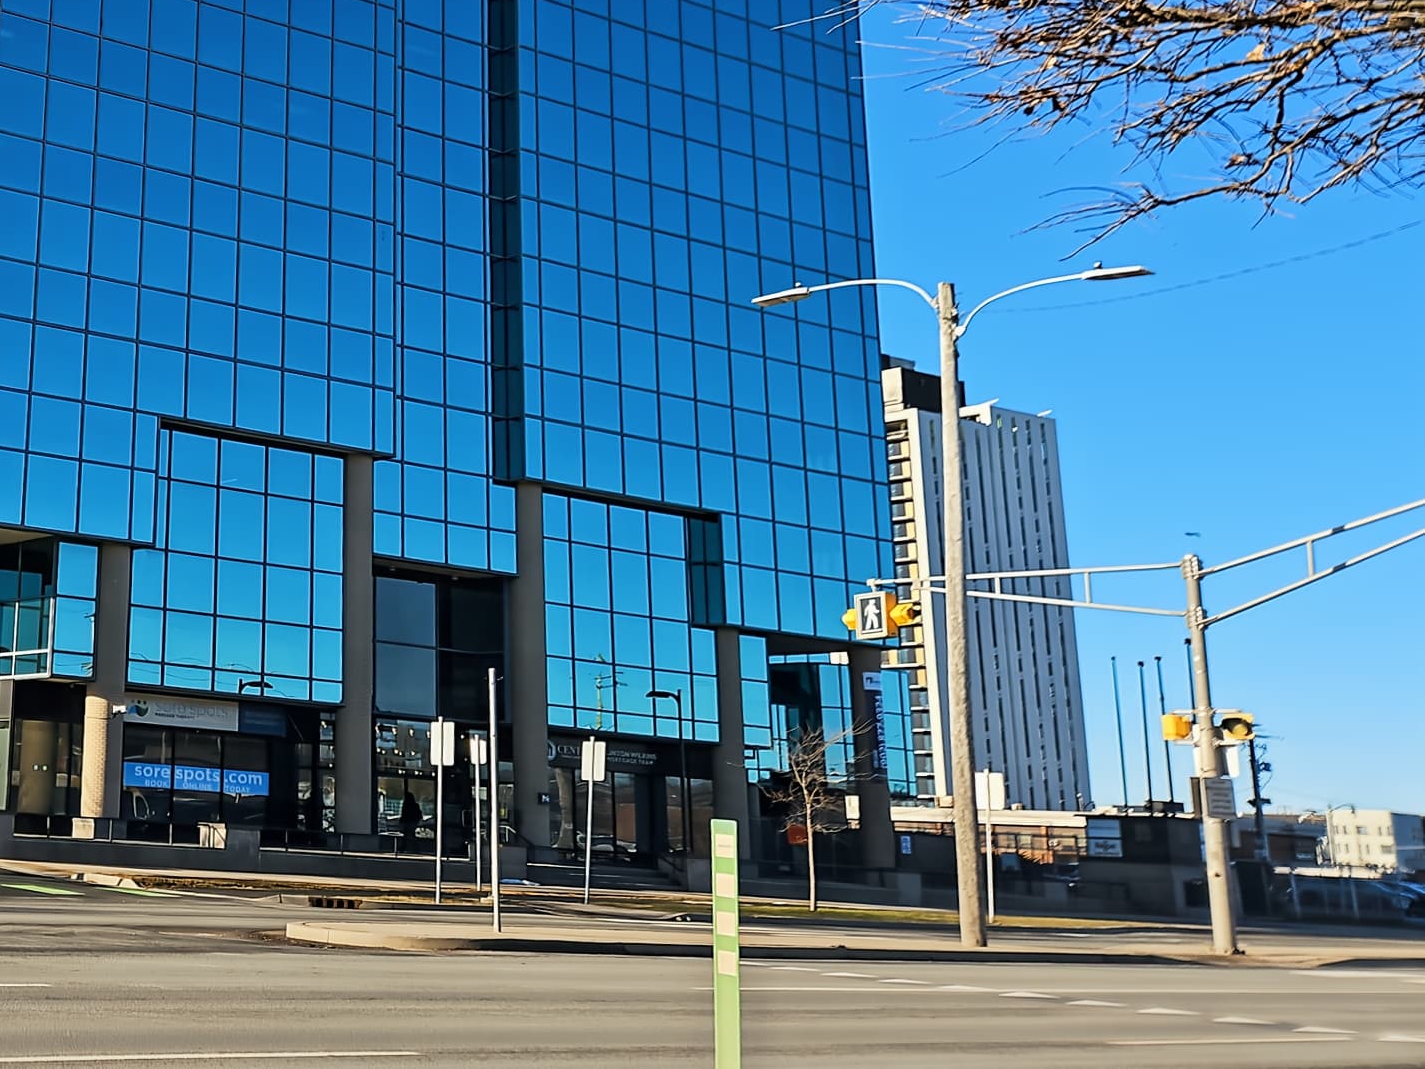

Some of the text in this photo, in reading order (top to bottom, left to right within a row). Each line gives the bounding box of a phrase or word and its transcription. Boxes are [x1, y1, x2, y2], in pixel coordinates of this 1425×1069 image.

[144, 779, 251, 793] BOOK ONLINE TODAY
